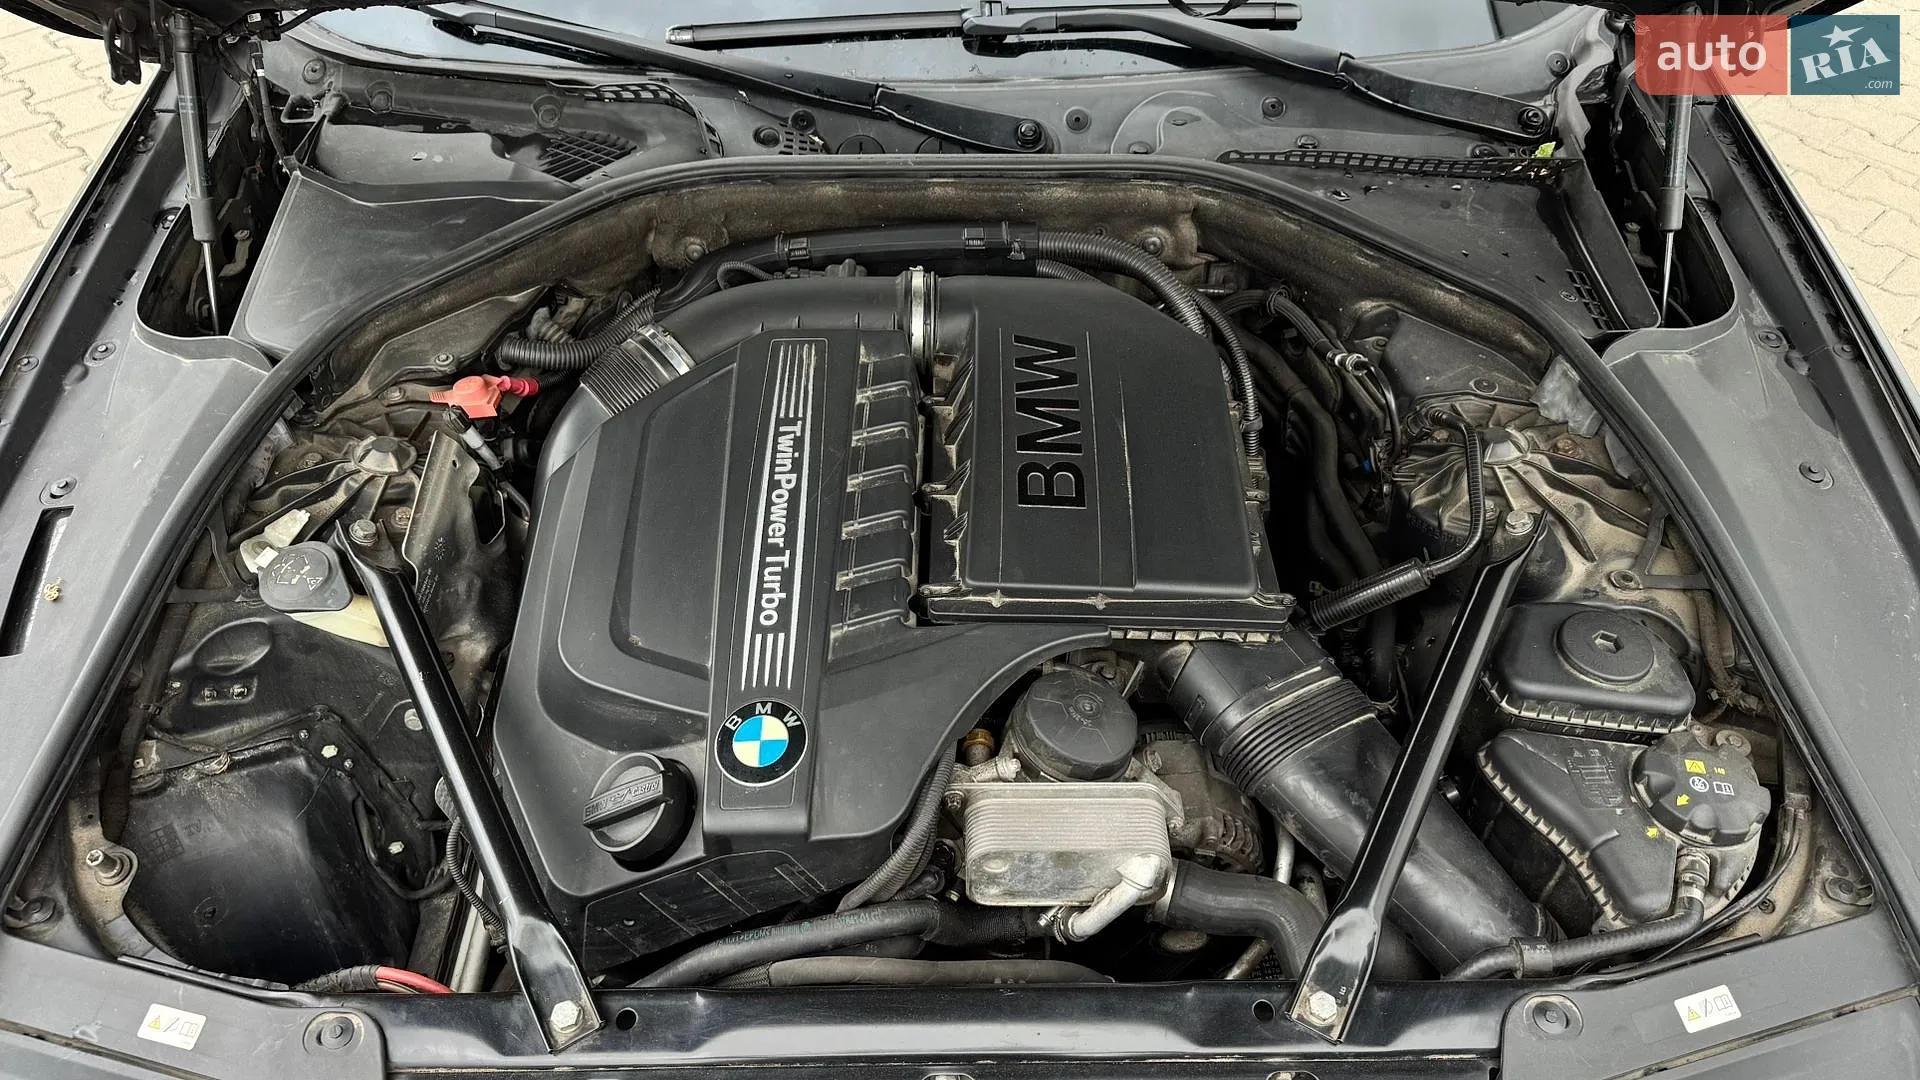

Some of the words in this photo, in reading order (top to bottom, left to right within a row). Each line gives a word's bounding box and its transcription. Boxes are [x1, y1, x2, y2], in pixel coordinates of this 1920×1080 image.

[1012, 334, 1087, 509] BMW
[767, 421, 802, 548] TwinPower
[759, 549, 790, 626] Turbo
[725, 702, 801, 731] BMW
